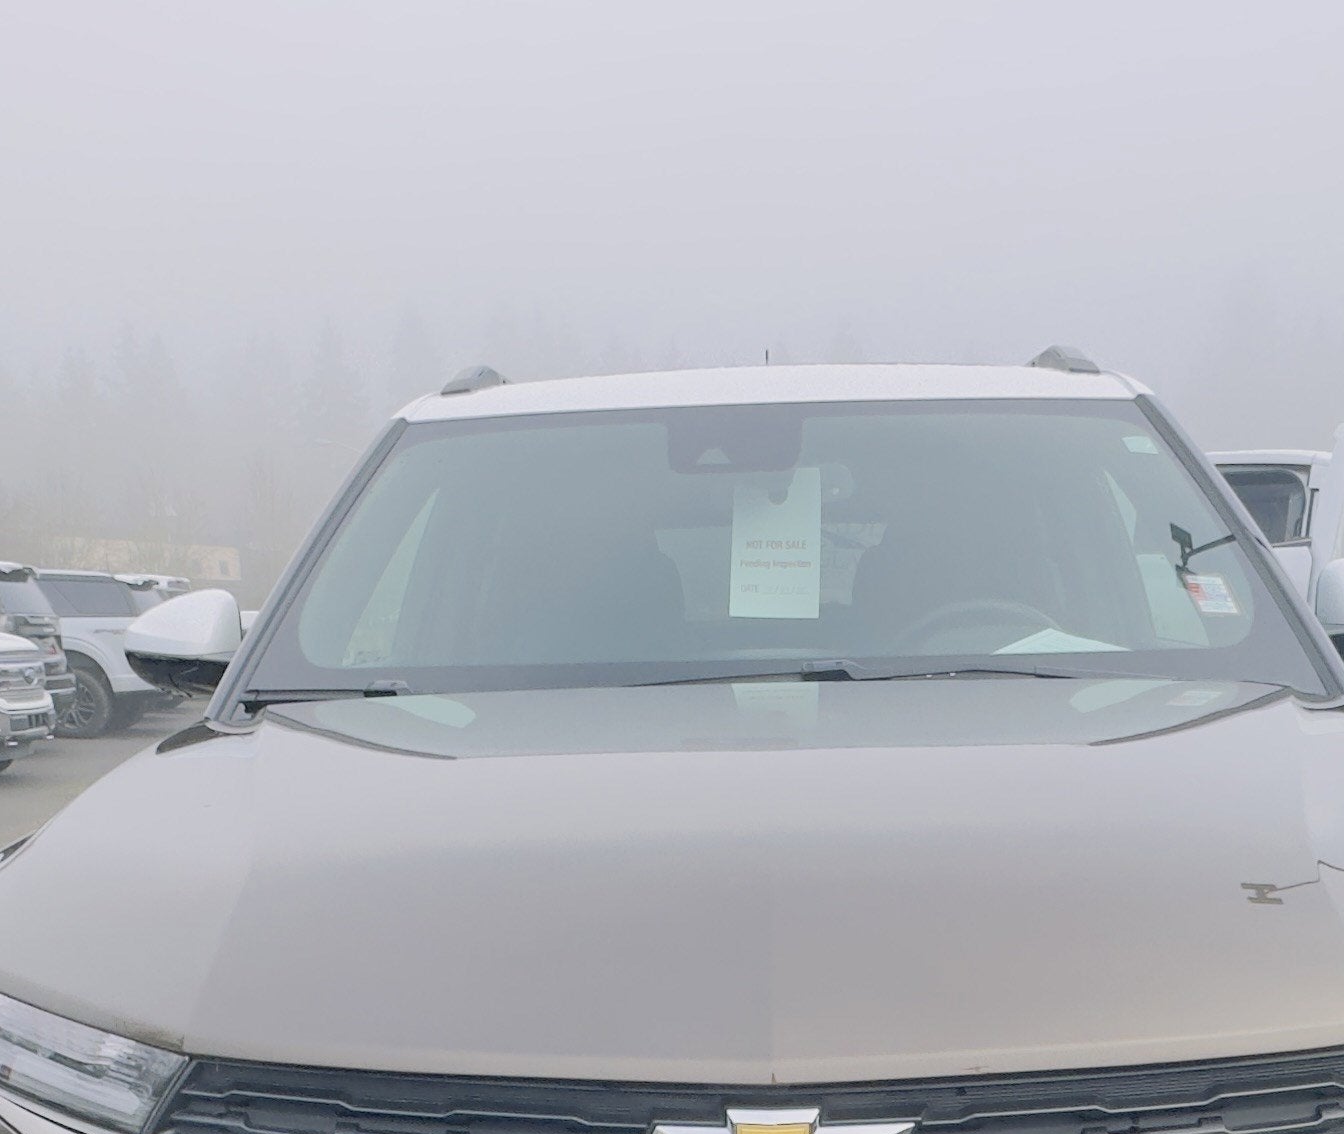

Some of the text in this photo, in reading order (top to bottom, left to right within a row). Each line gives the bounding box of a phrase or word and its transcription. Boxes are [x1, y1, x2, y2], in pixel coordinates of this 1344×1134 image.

[746, 540, 807, 550] NOT FOR SALE
